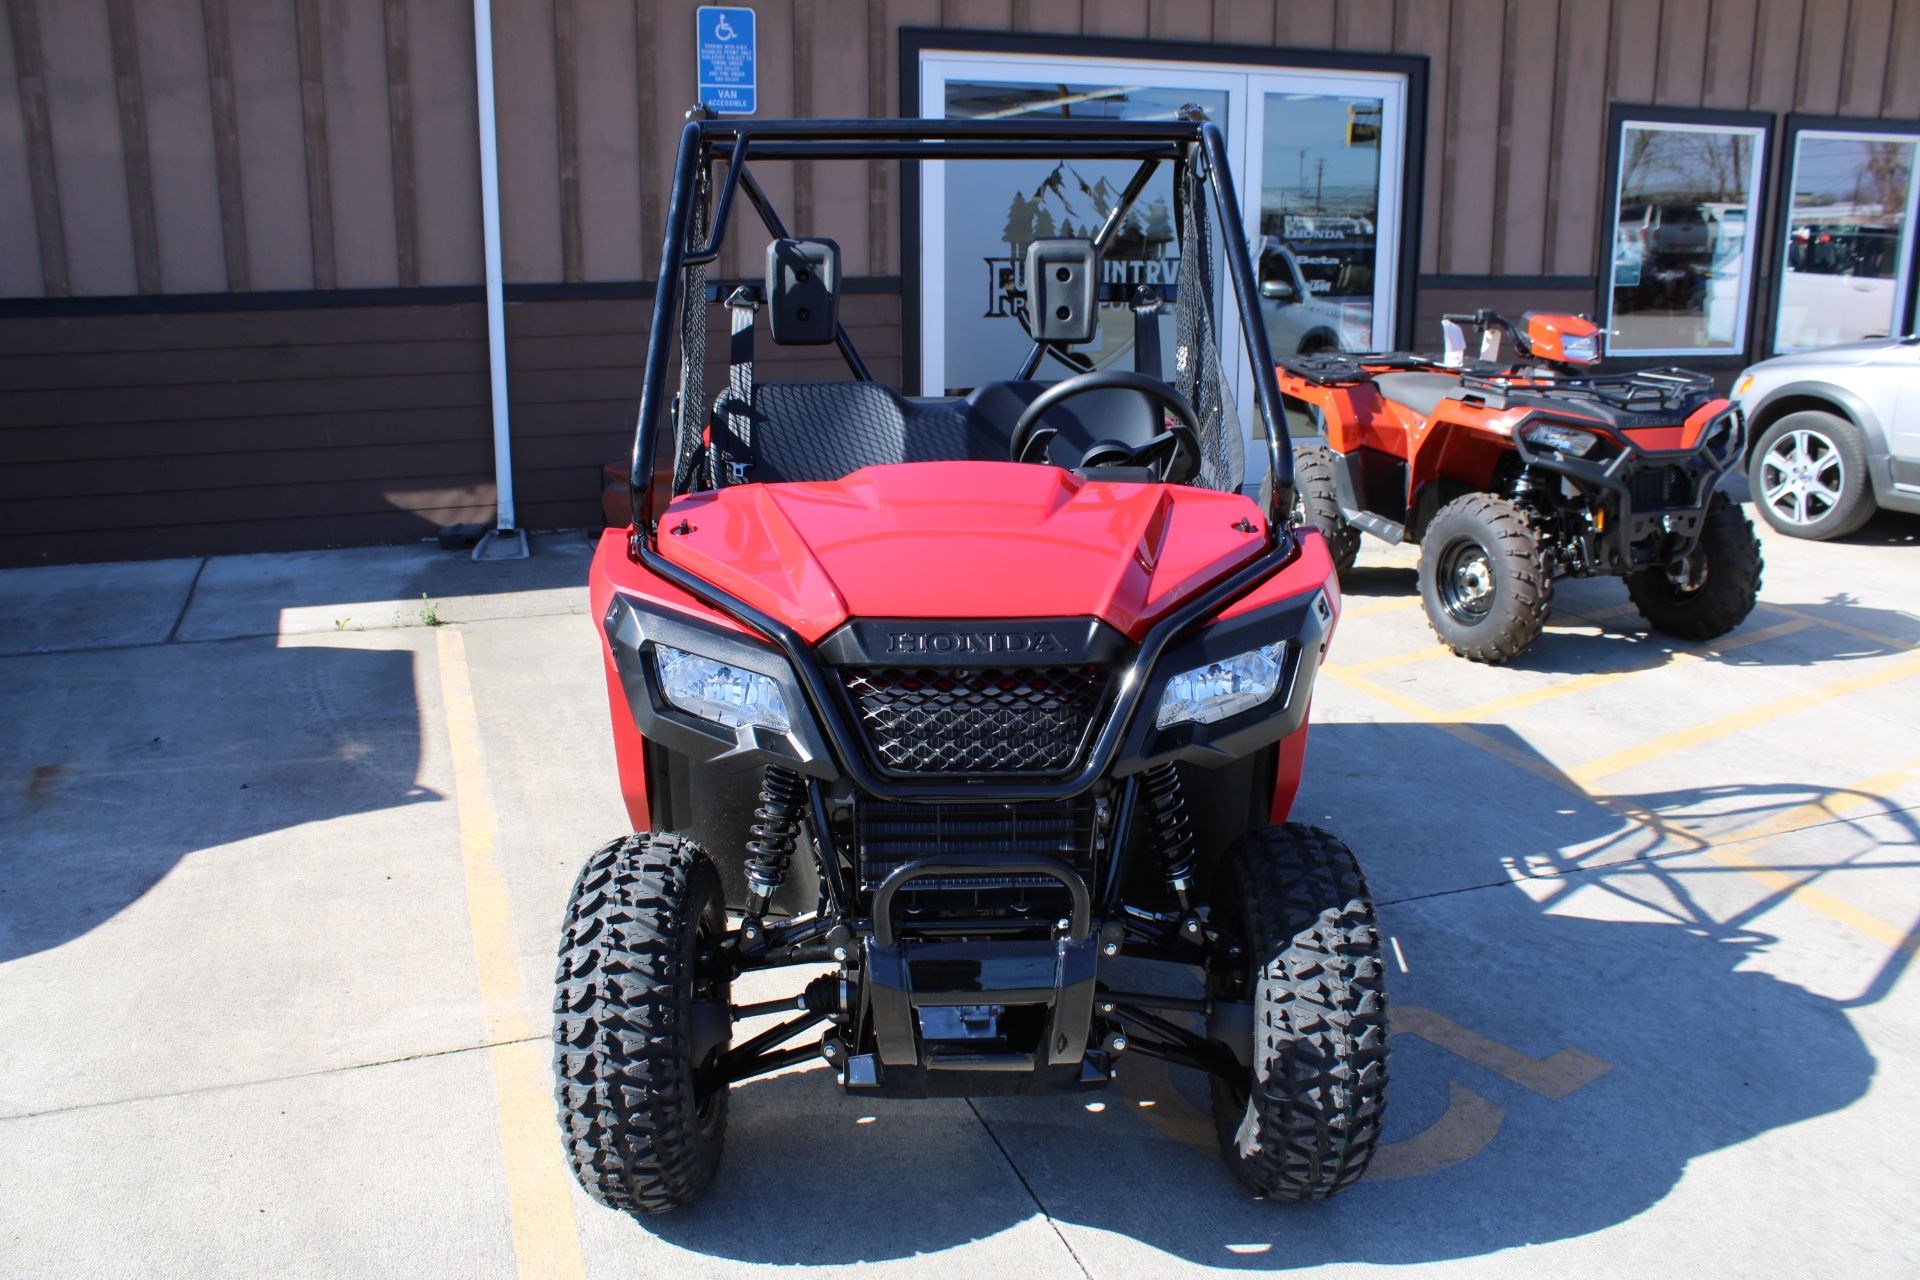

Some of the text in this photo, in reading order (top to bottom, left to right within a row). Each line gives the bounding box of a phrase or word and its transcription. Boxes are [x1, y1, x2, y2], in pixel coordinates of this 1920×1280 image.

[718, 90, 737, 99] VAN
[1294, 229, 1345, 239] HONDA
[1296, 255, 1340, 264] Beta
[886, 632, 1068, 653] HONDA
